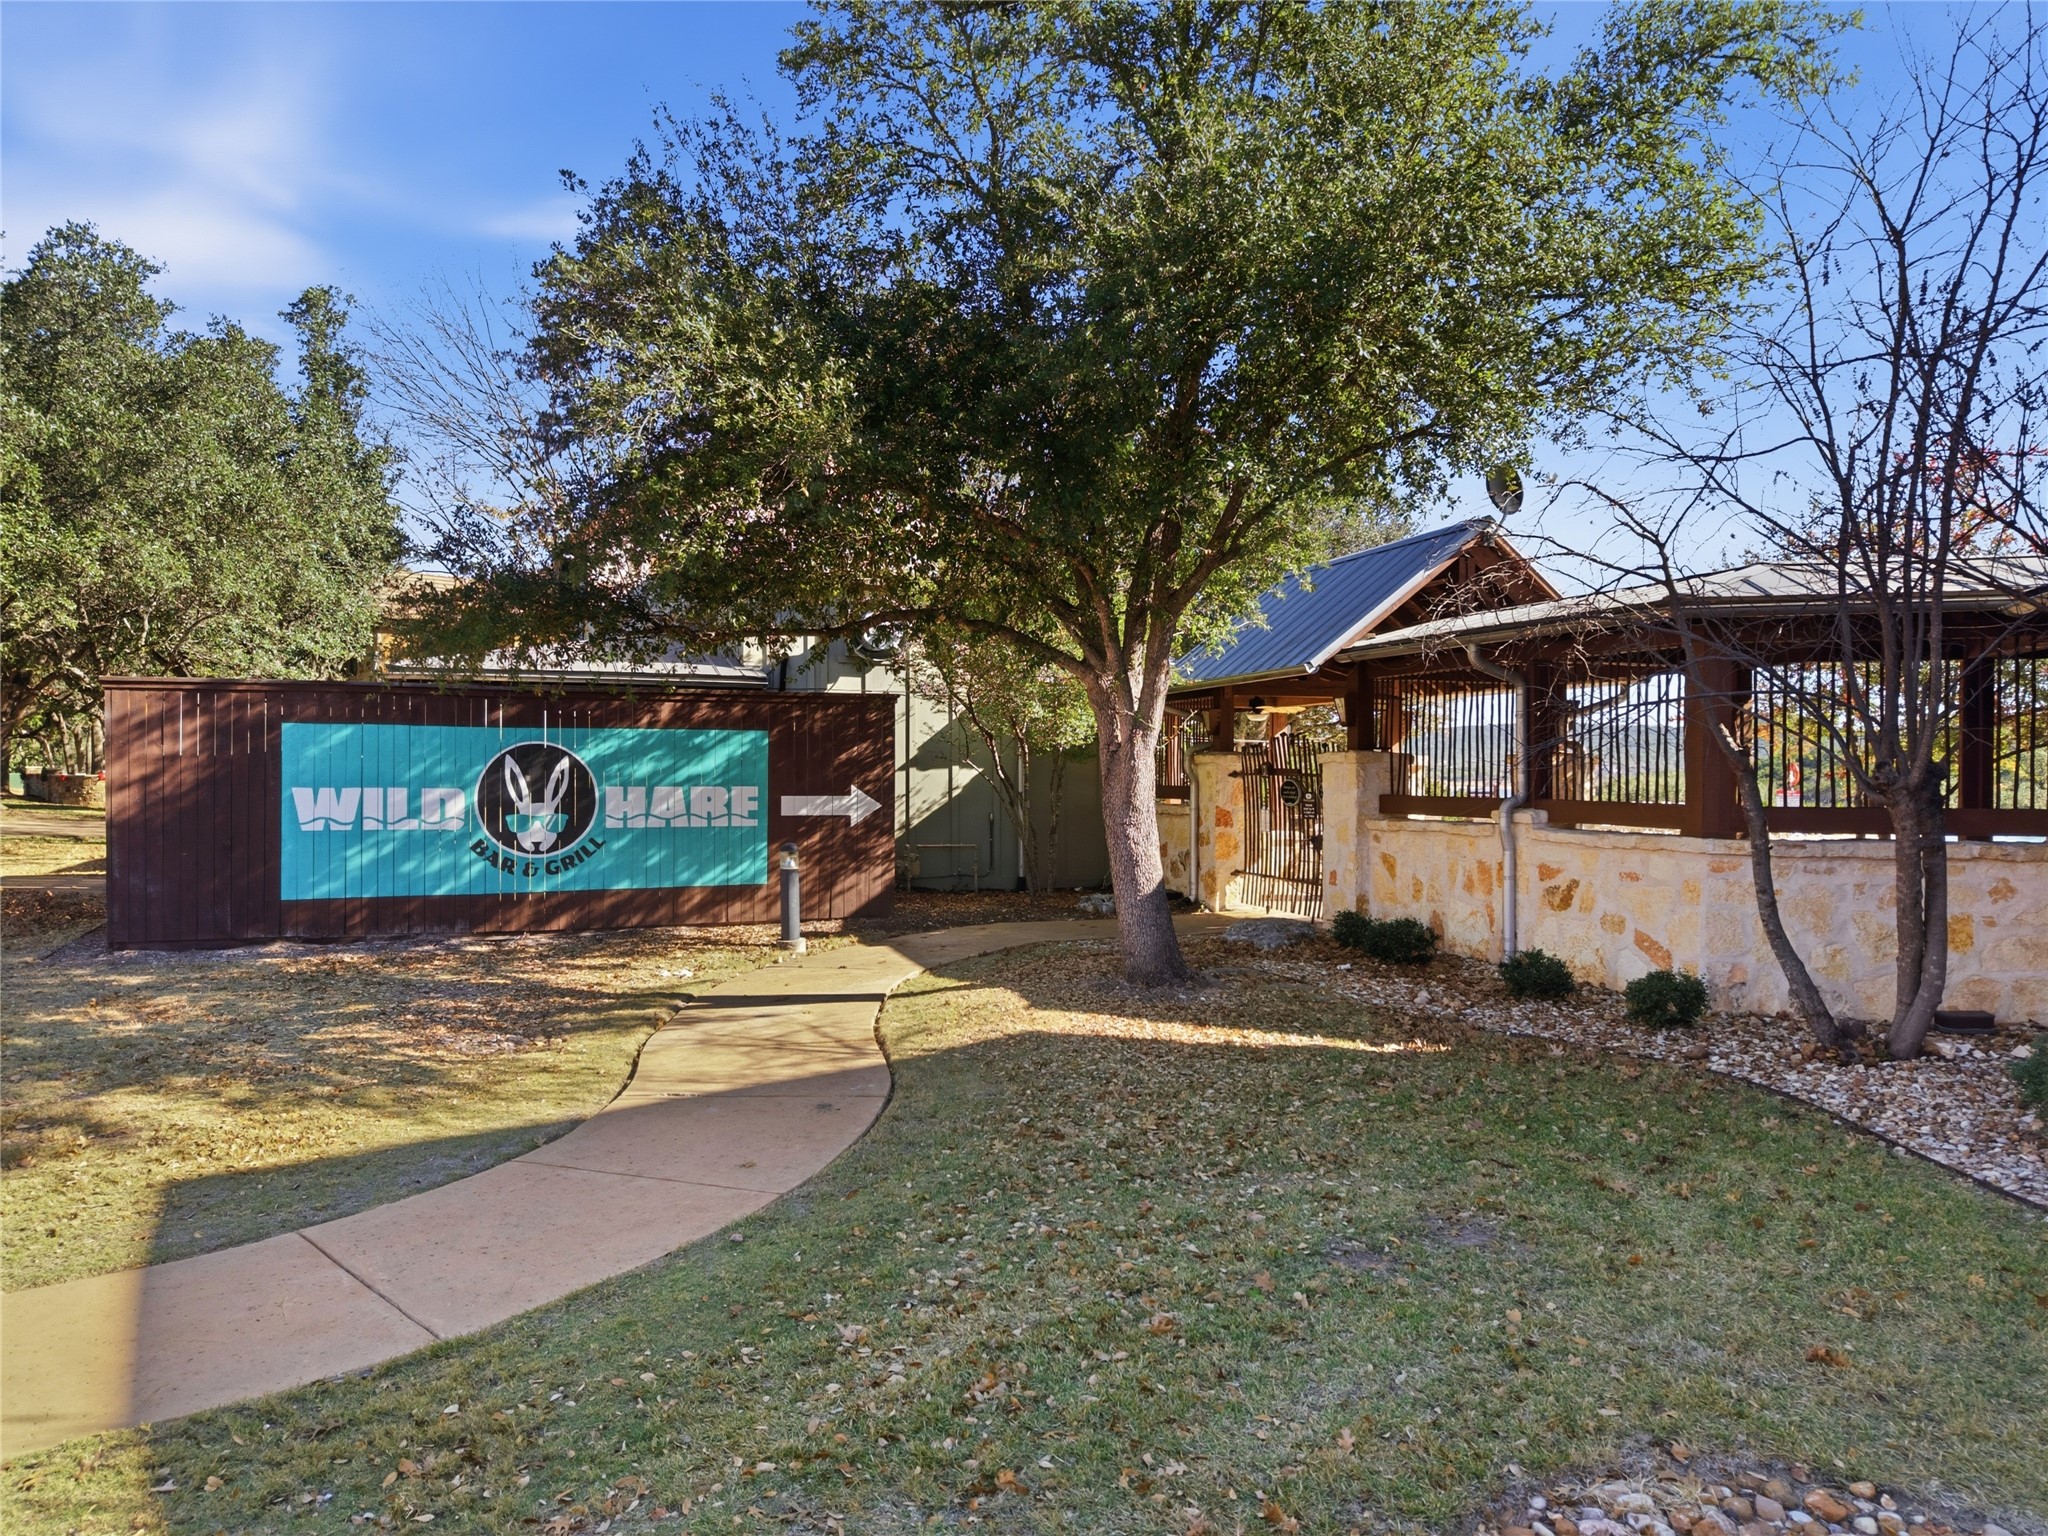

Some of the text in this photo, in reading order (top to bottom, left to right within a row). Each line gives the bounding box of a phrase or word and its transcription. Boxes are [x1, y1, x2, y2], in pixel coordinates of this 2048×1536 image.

[291, 786, 758, 831] WILD HARE
[470, 837, 606, 877] BAR & GRILL
